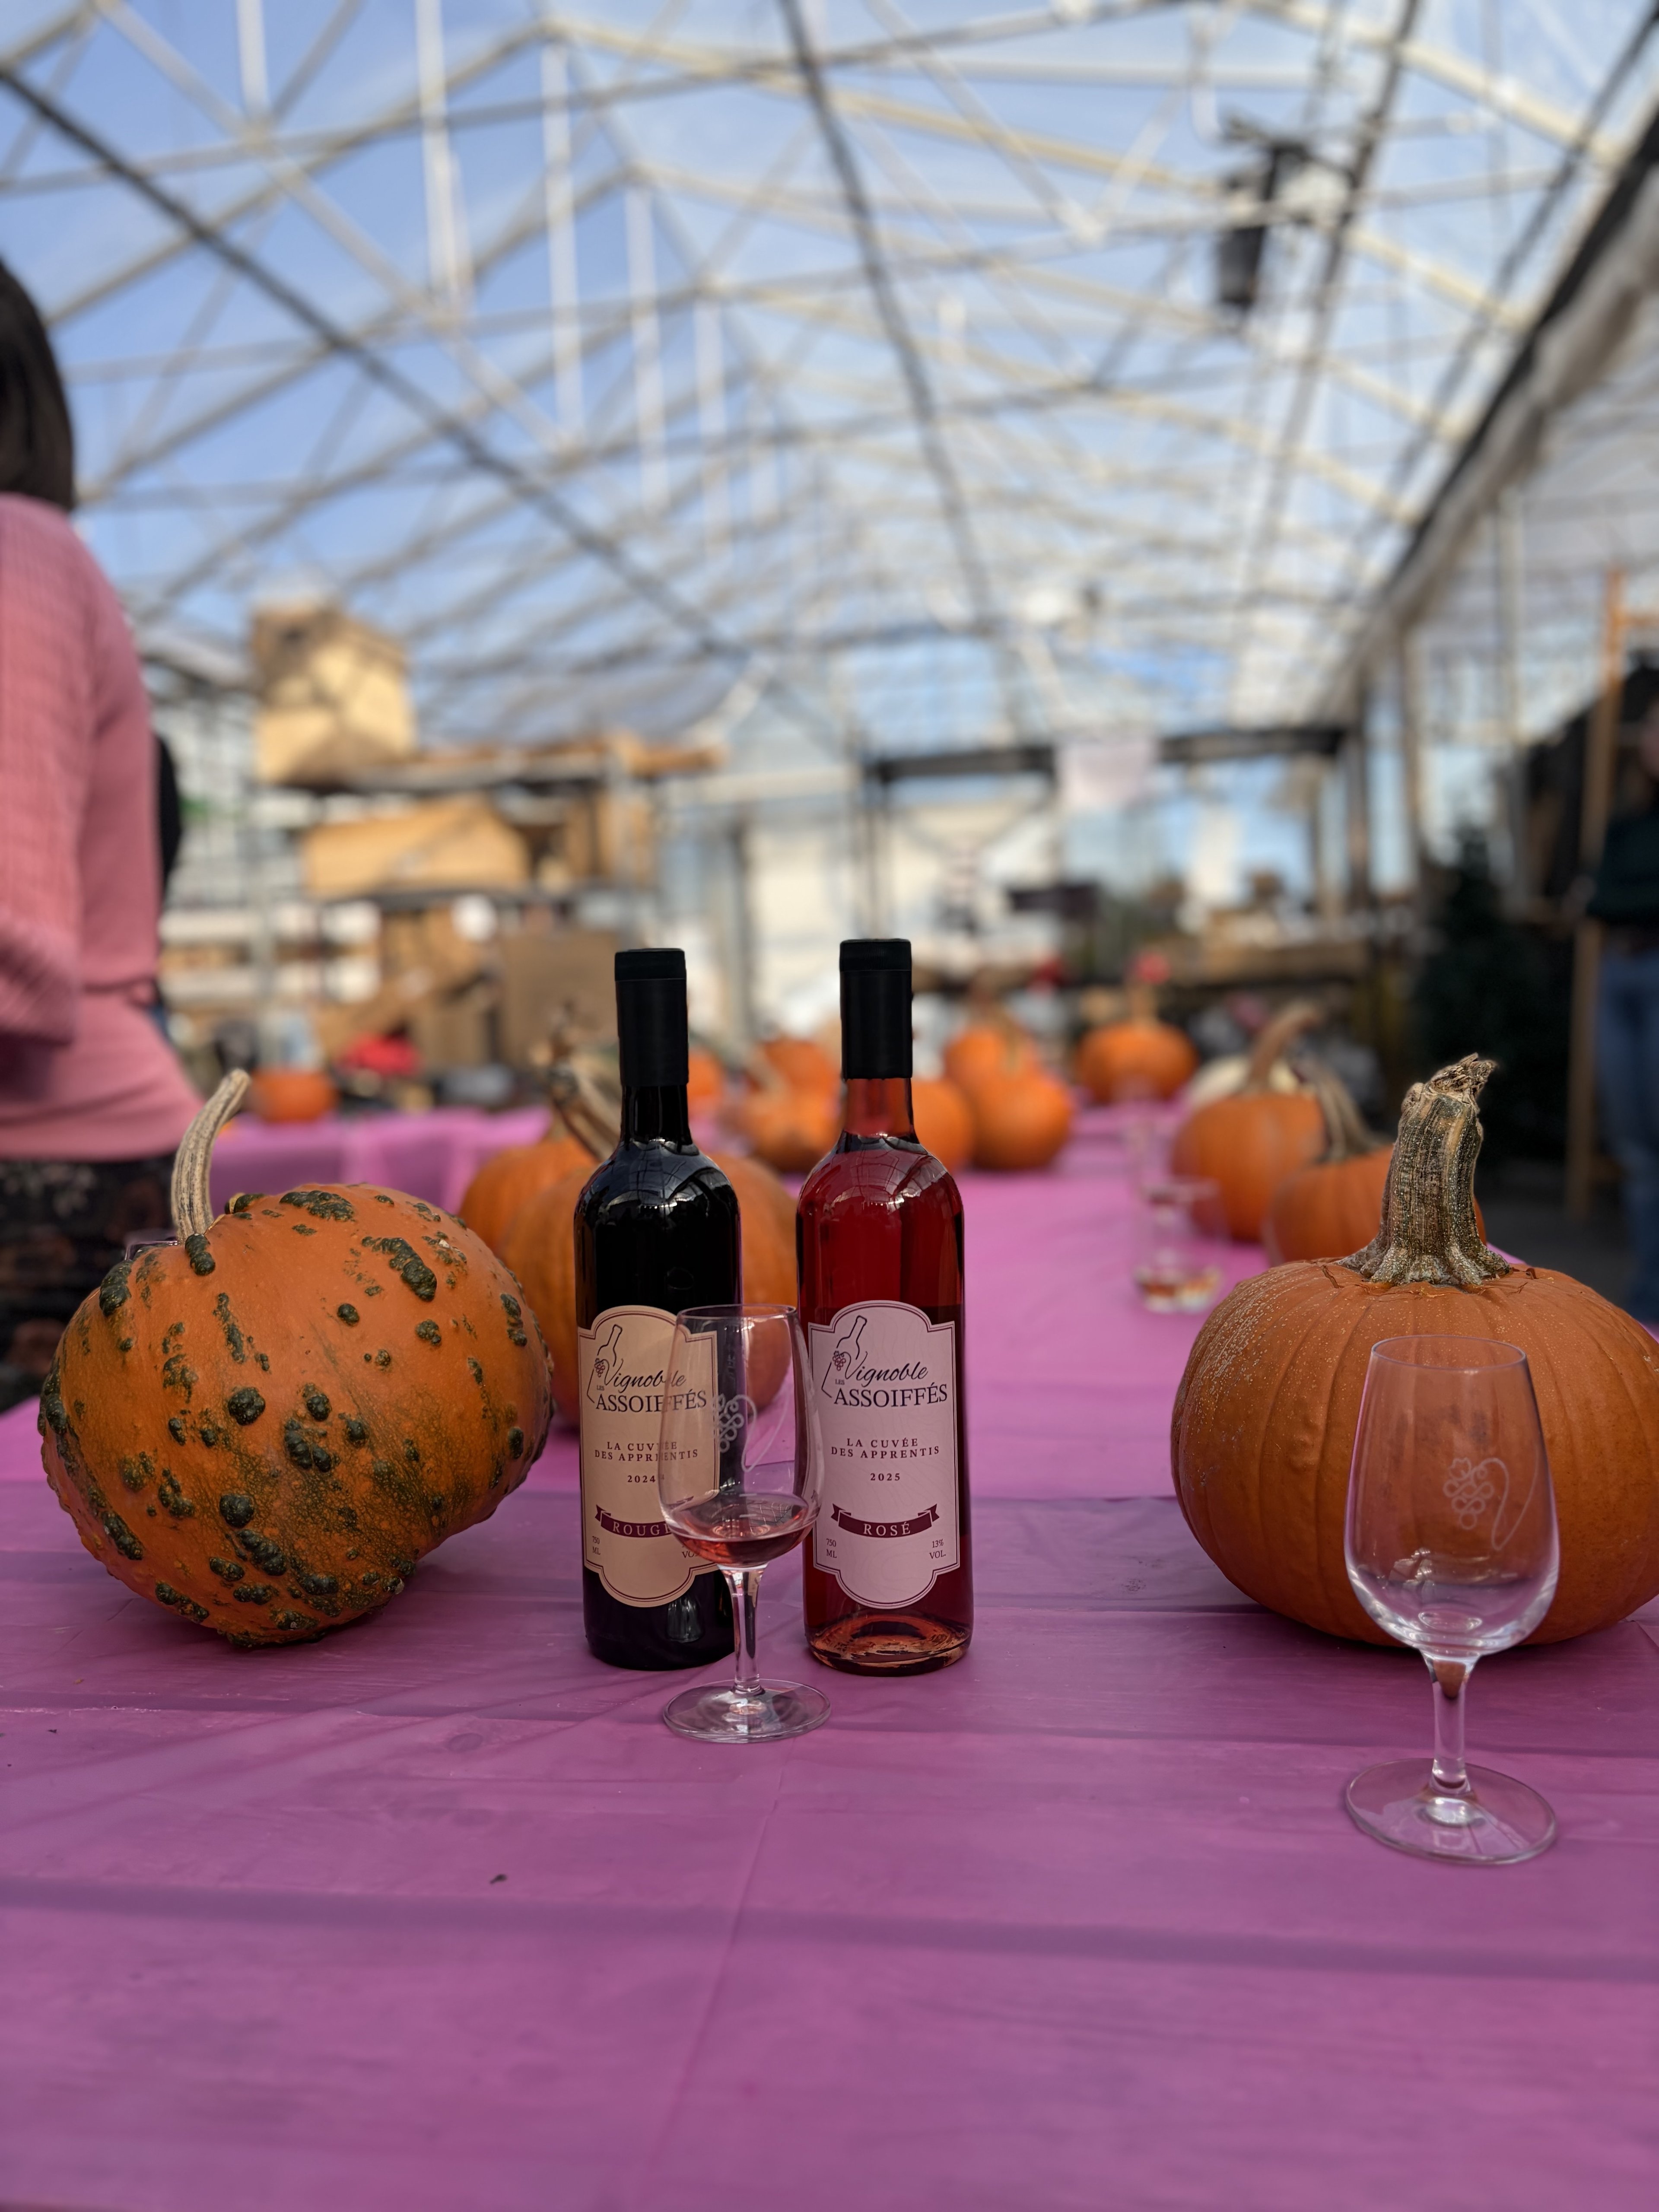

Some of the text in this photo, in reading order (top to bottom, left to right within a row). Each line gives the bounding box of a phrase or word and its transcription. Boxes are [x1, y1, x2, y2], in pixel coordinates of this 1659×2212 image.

[842, 1351, 928, 1387] Vignoble
[601, 1358, 686, 1393] Vignoble
[834, 1382, 947, 1407] ASSOIFFÉS
[596, 1389, 707, 1412] ASSOIFFÉS
[607, 1442, 621, 1450] LA
[847, 1438, 918, 1448] LA CUVÉE
[595, 1450, 613, 1460] DES
[831, 1446, 939, 1459] DES APPRENTIS
[871, 1473, 900, 1481] 2025
[864, 1522, 910, 1536] ROSÉ
[826, 1538, 836, 1547] 750
[932, 1539, 944, 1548] 13%
[592, 1546, 601, 1555] ML
[826, 1549, 837, 1558] ML
